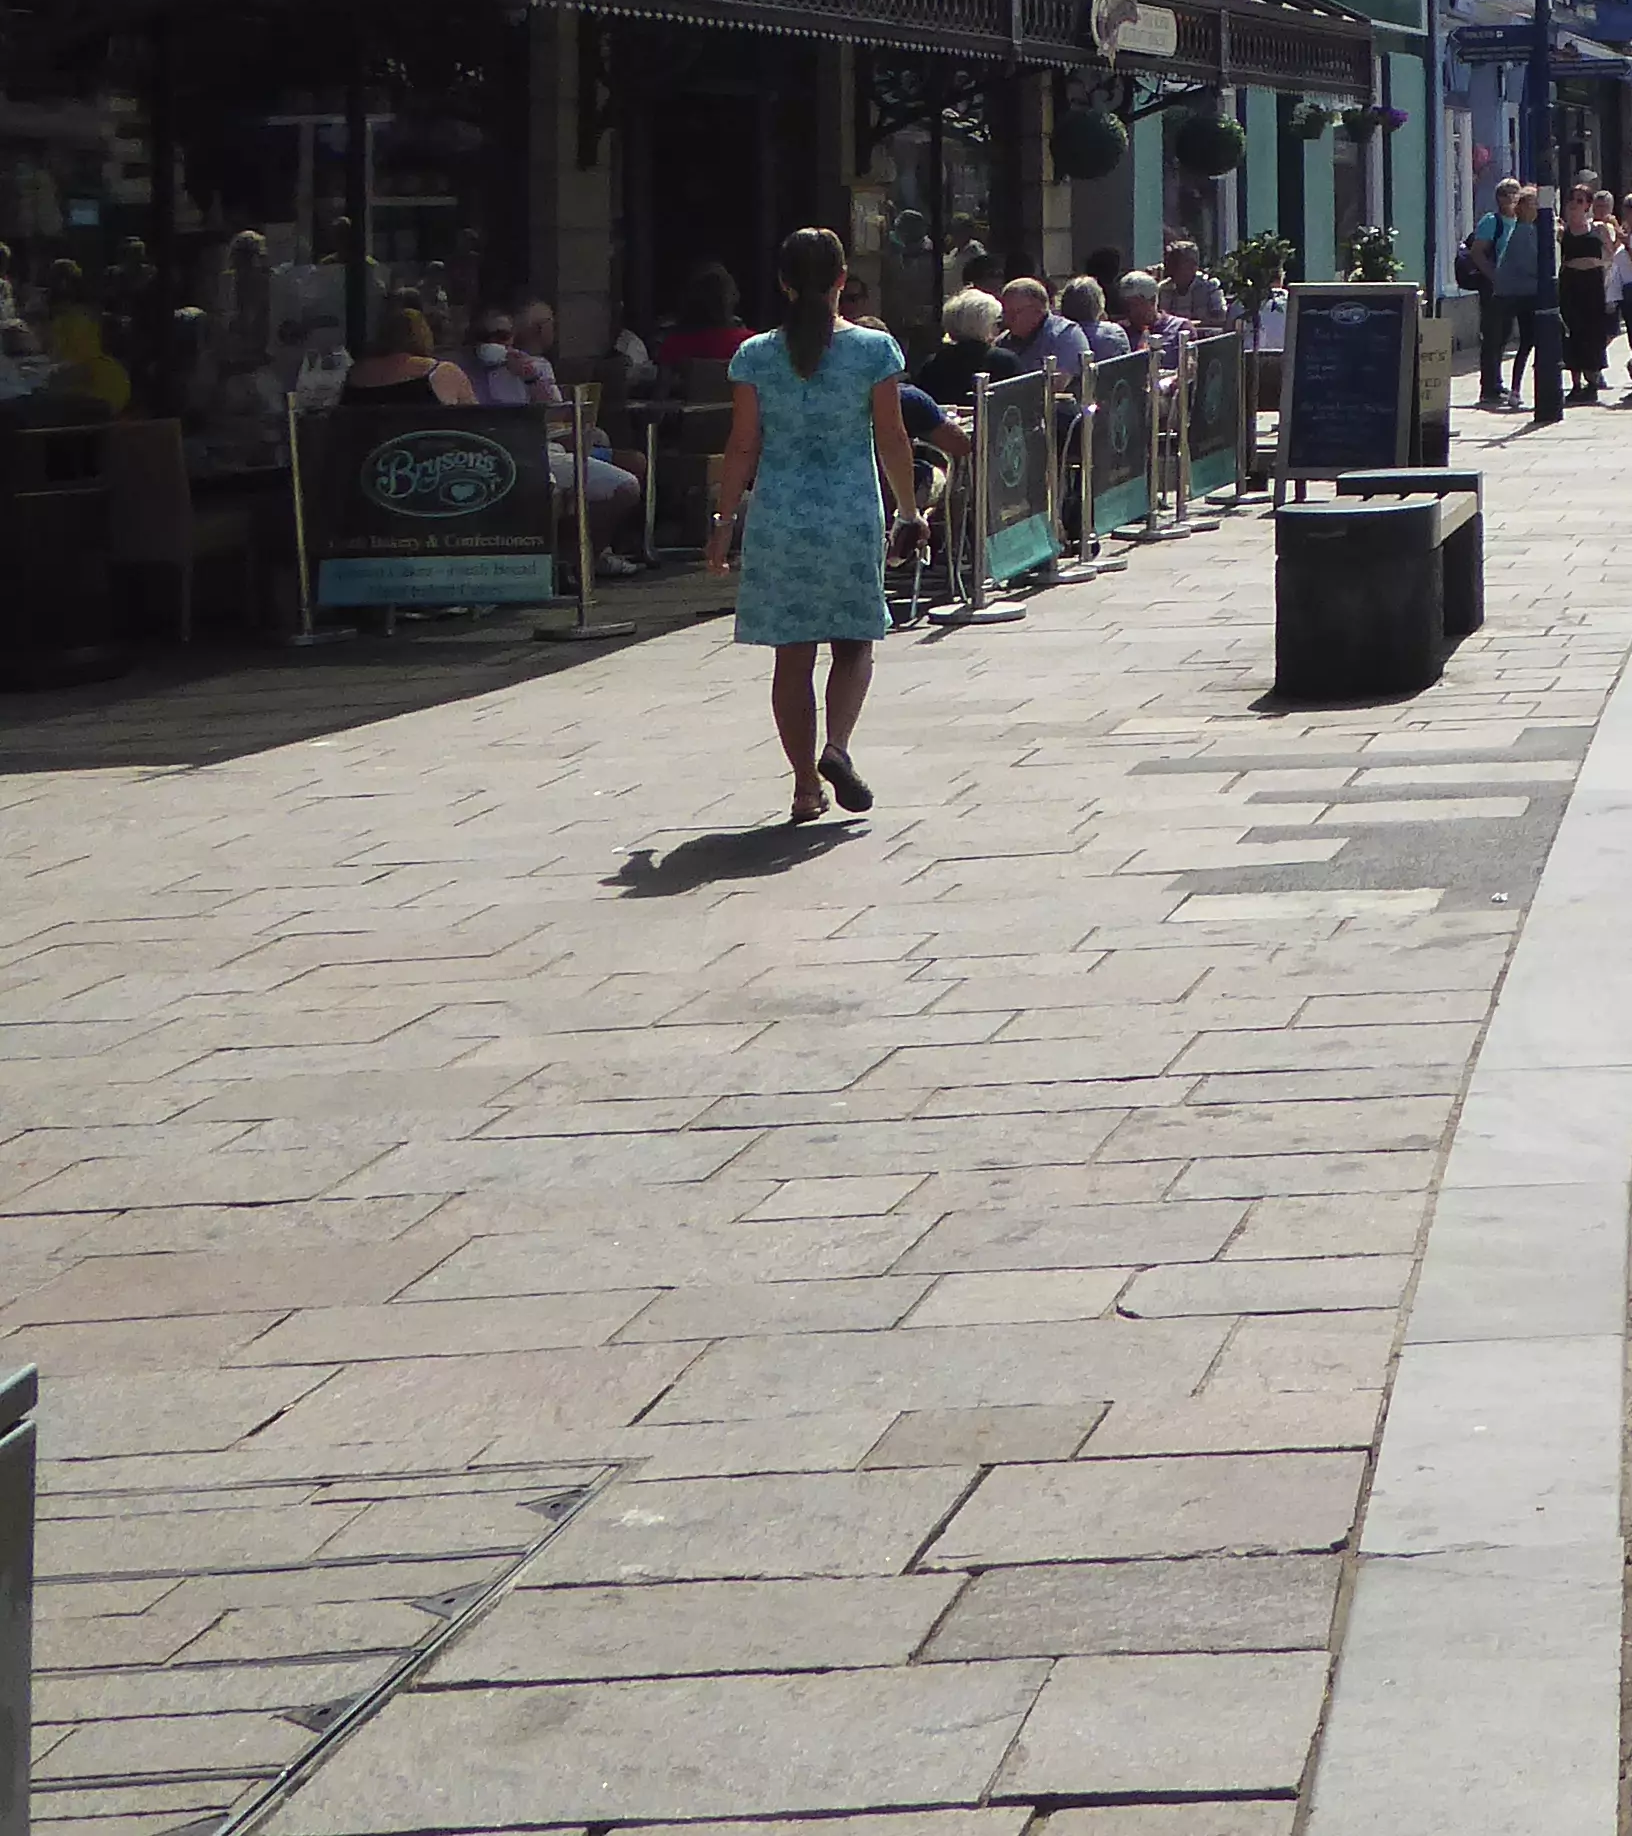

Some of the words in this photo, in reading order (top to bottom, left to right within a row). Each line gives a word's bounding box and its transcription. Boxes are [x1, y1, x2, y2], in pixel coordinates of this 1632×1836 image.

[375, 449, 500, 498] Bryson's
[426, 533, 439, 549] &
[445, 533, 544, 550] Confectioners
